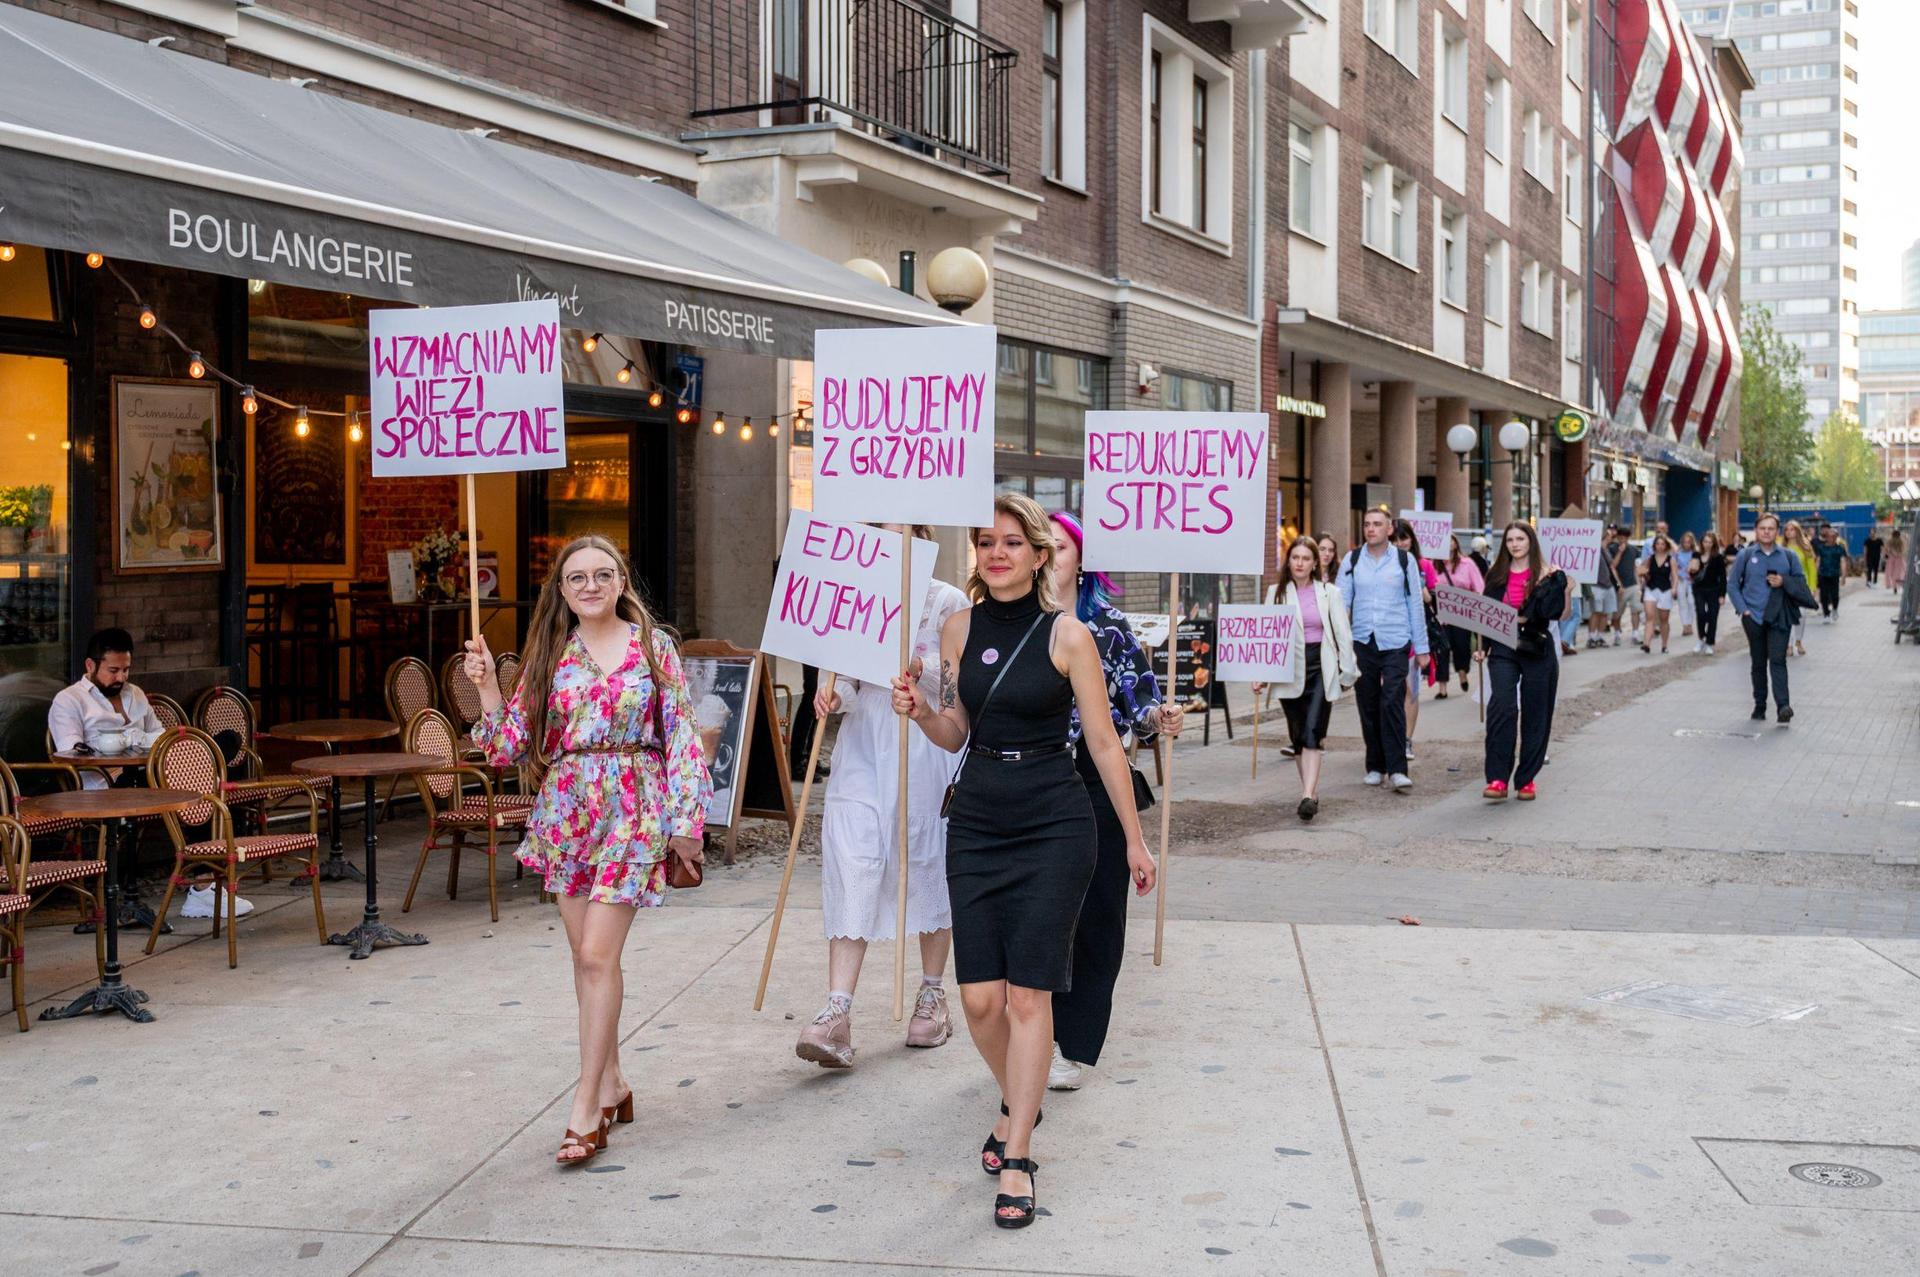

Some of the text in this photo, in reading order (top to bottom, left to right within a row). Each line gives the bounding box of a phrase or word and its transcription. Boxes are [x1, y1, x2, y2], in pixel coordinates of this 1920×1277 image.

[168, 208, 414, 287] BOULANGERIE
[665, 299, 775, 345] PATISSERIE
[374, 322, 558, 378] WZMACNIAMY
[822, 372, 986, 436] BUDUJEMY
[376, 406, 560, 459] SPOŁECZNE
[820, 435, 965, 480] Z GRZYBNI
[1088, 428, 1265, 480] REDUKUJEMY
[1099, 481, 1234, 535] STRES
[802, 519, 891, 568] EDU-
[1550, 544, 1598, 572] KOSZTY
[780, 570, 902, 644] KUJEMY
[1437, 590, 1516, 624] OCZYSZCZAMY
[1439, 602, 1512, 636] POWIETRZE
[1218, 641, 1289, 667] DO NATURY
